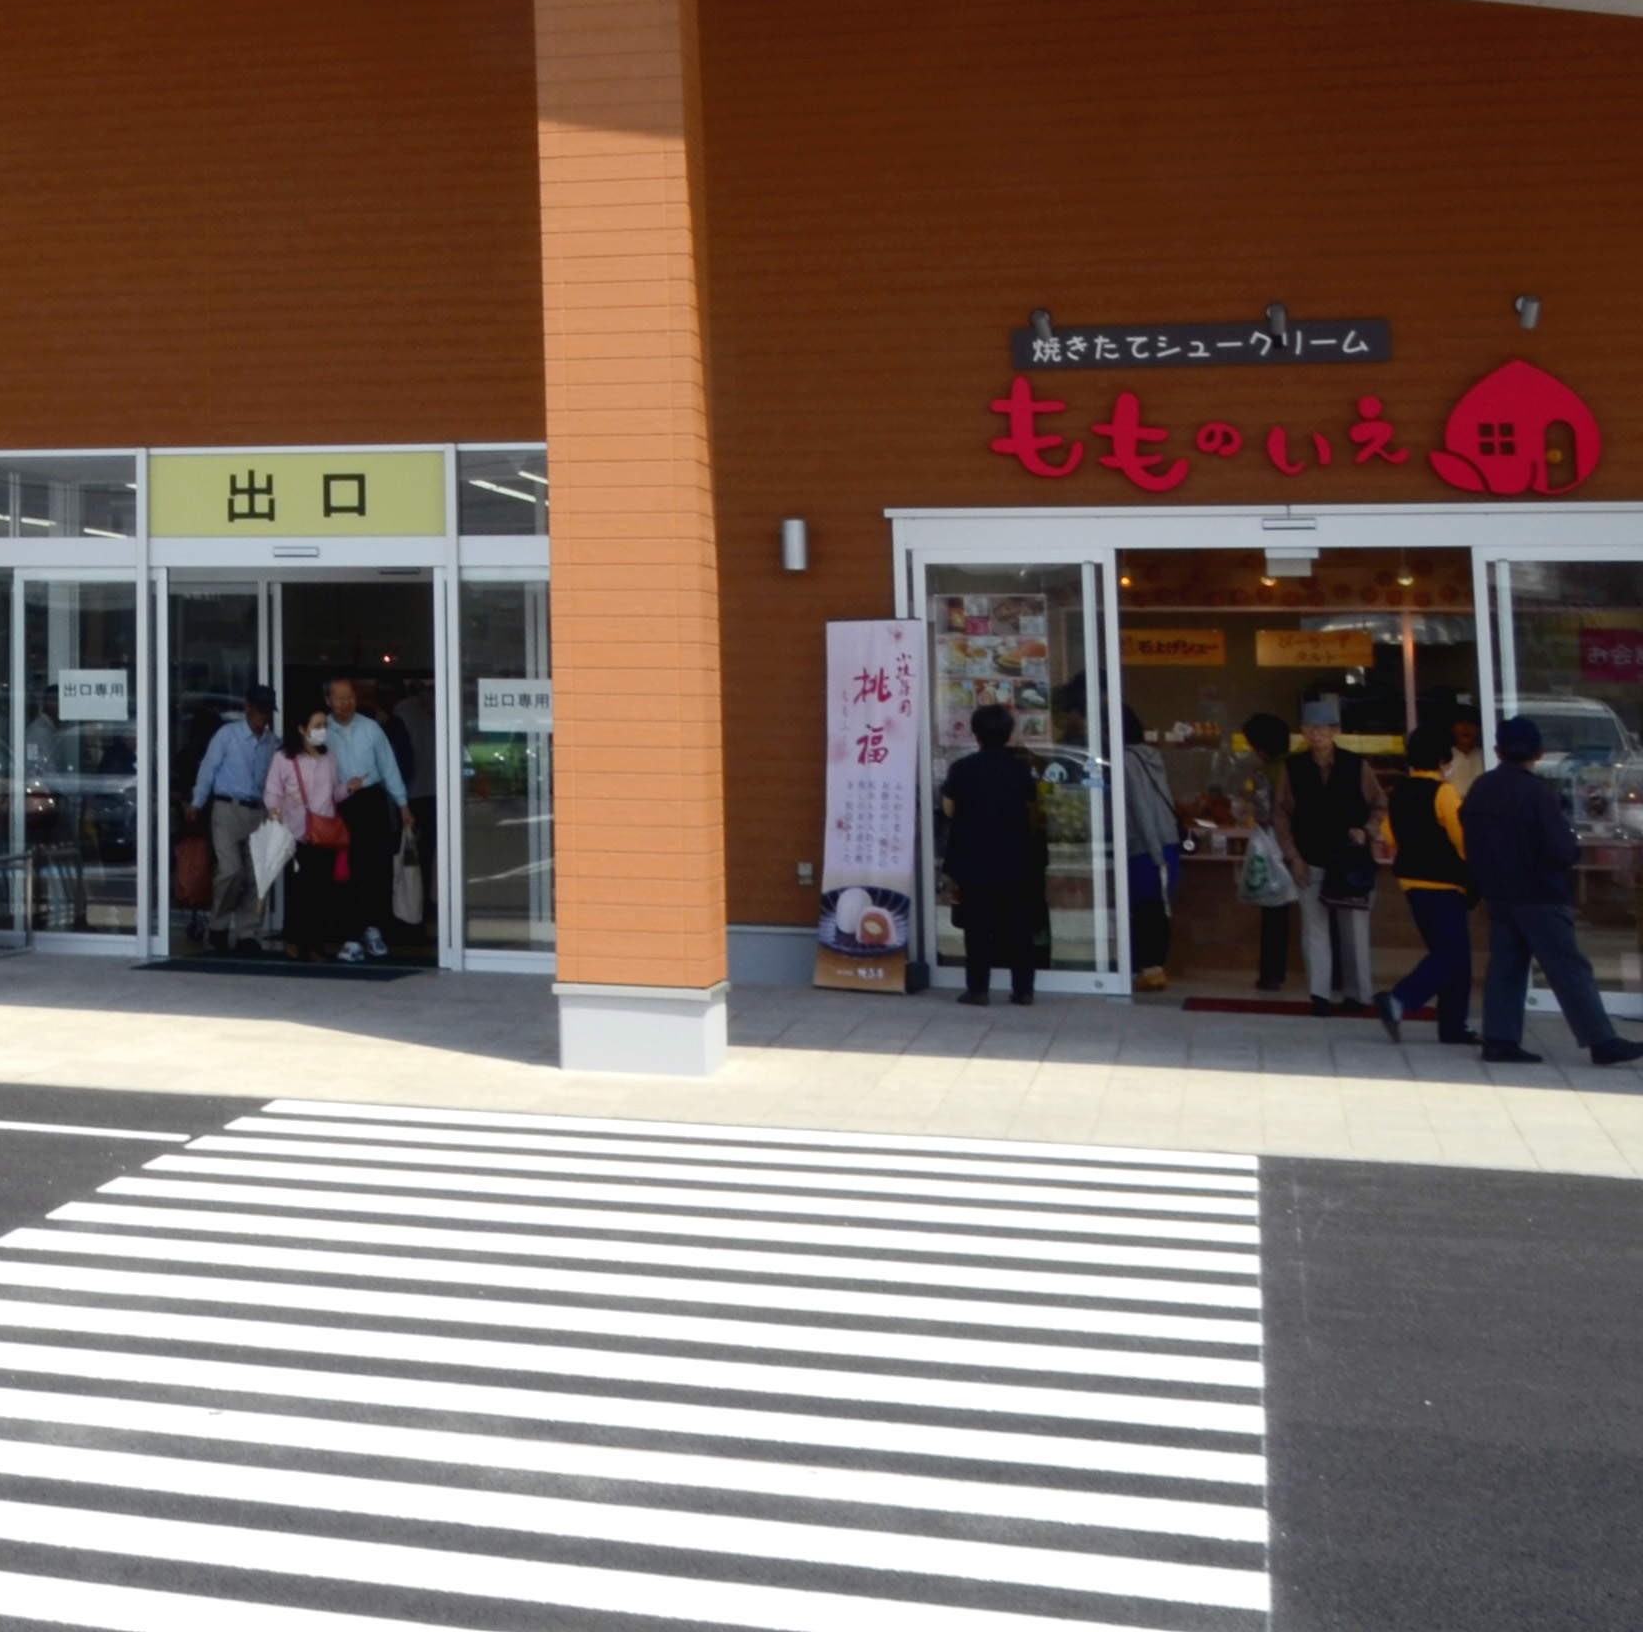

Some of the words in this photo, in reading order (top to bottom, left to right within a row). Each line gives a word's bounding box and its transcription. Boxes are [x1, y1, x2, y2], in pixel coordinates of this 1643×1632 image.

[1032, 321, 1370, 363] 焼きたてシュークリーム
[990, 375, 1410, 492] もものいえ
[228, 469, 366, 523] 出口
[63, 682, 124, 698] 出口専用
[483, 692, 550, 709] 出口専用
